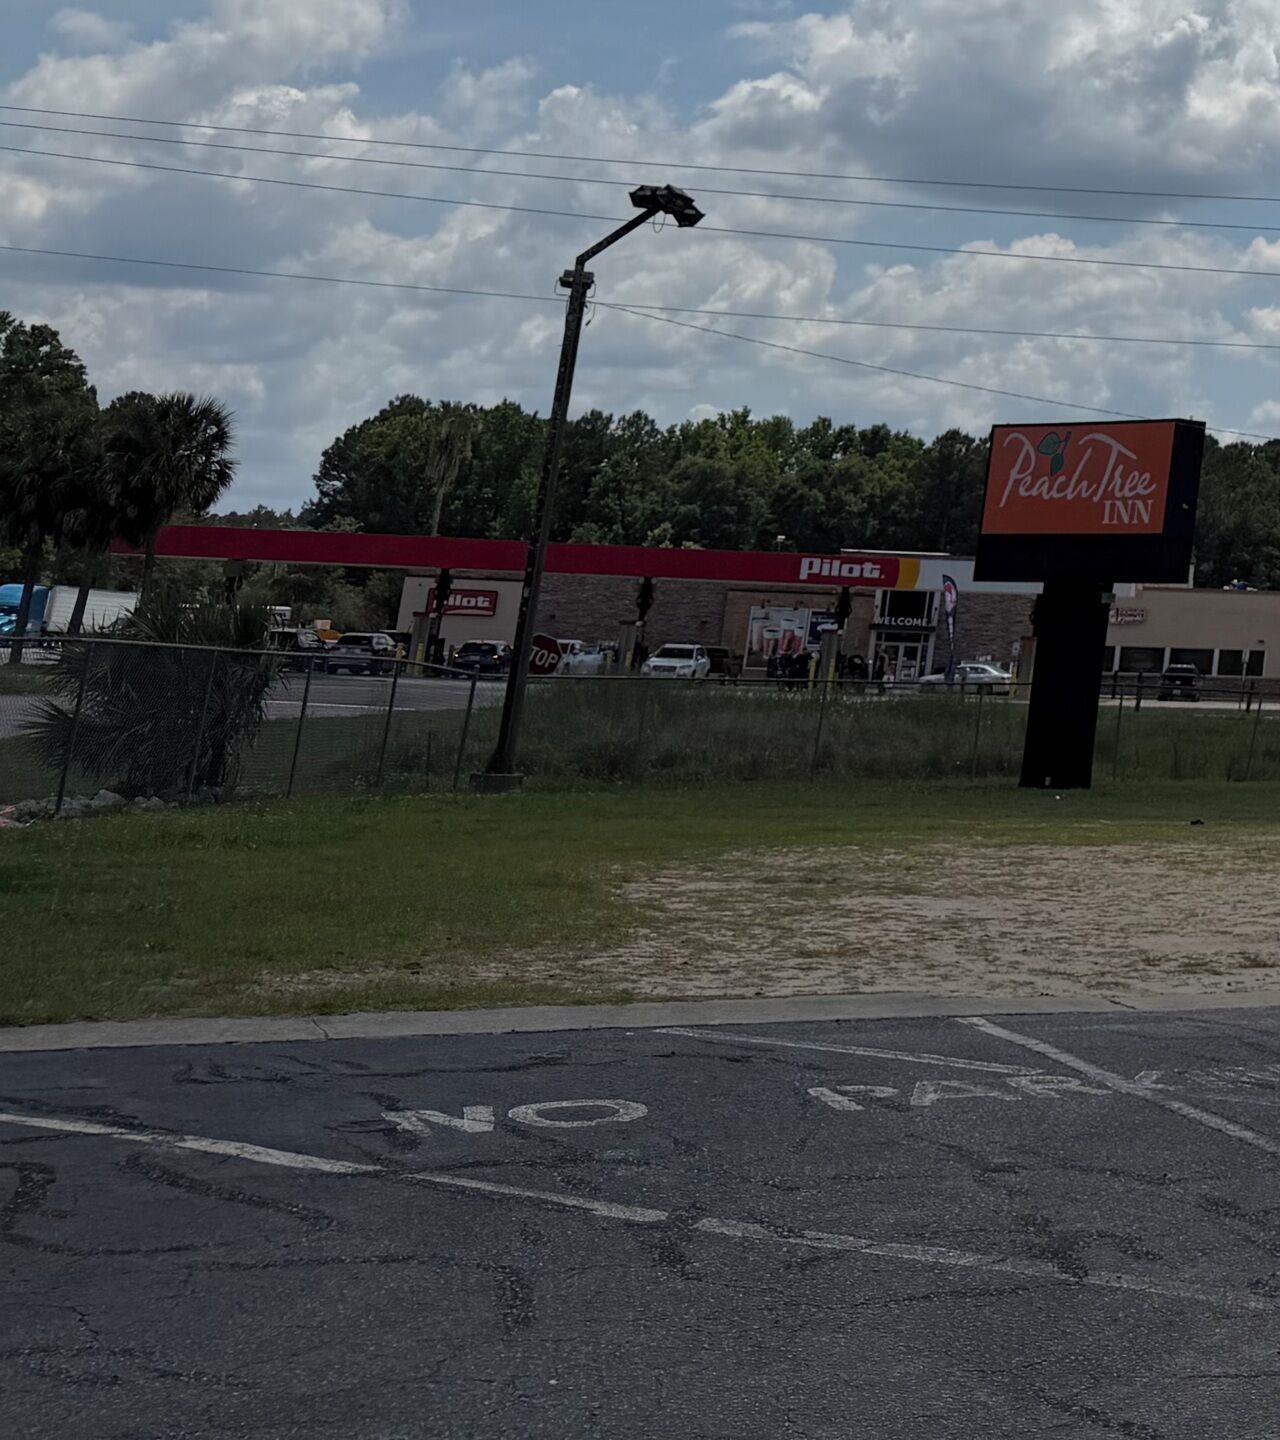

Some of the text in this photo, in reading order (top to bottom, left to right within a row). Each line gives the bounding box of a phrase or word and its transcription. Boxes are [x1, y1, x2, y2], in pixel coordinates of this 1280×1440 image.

[1101, 499, 1154, 525] INN
[801, 557, 882, 580] Pilot
[433, 594, 492, 608] ilot
[874, 616, 929, 627] WELCOME
[530, 645, 559, 668] TOP
[382, 1097, 649, 1136] NO
